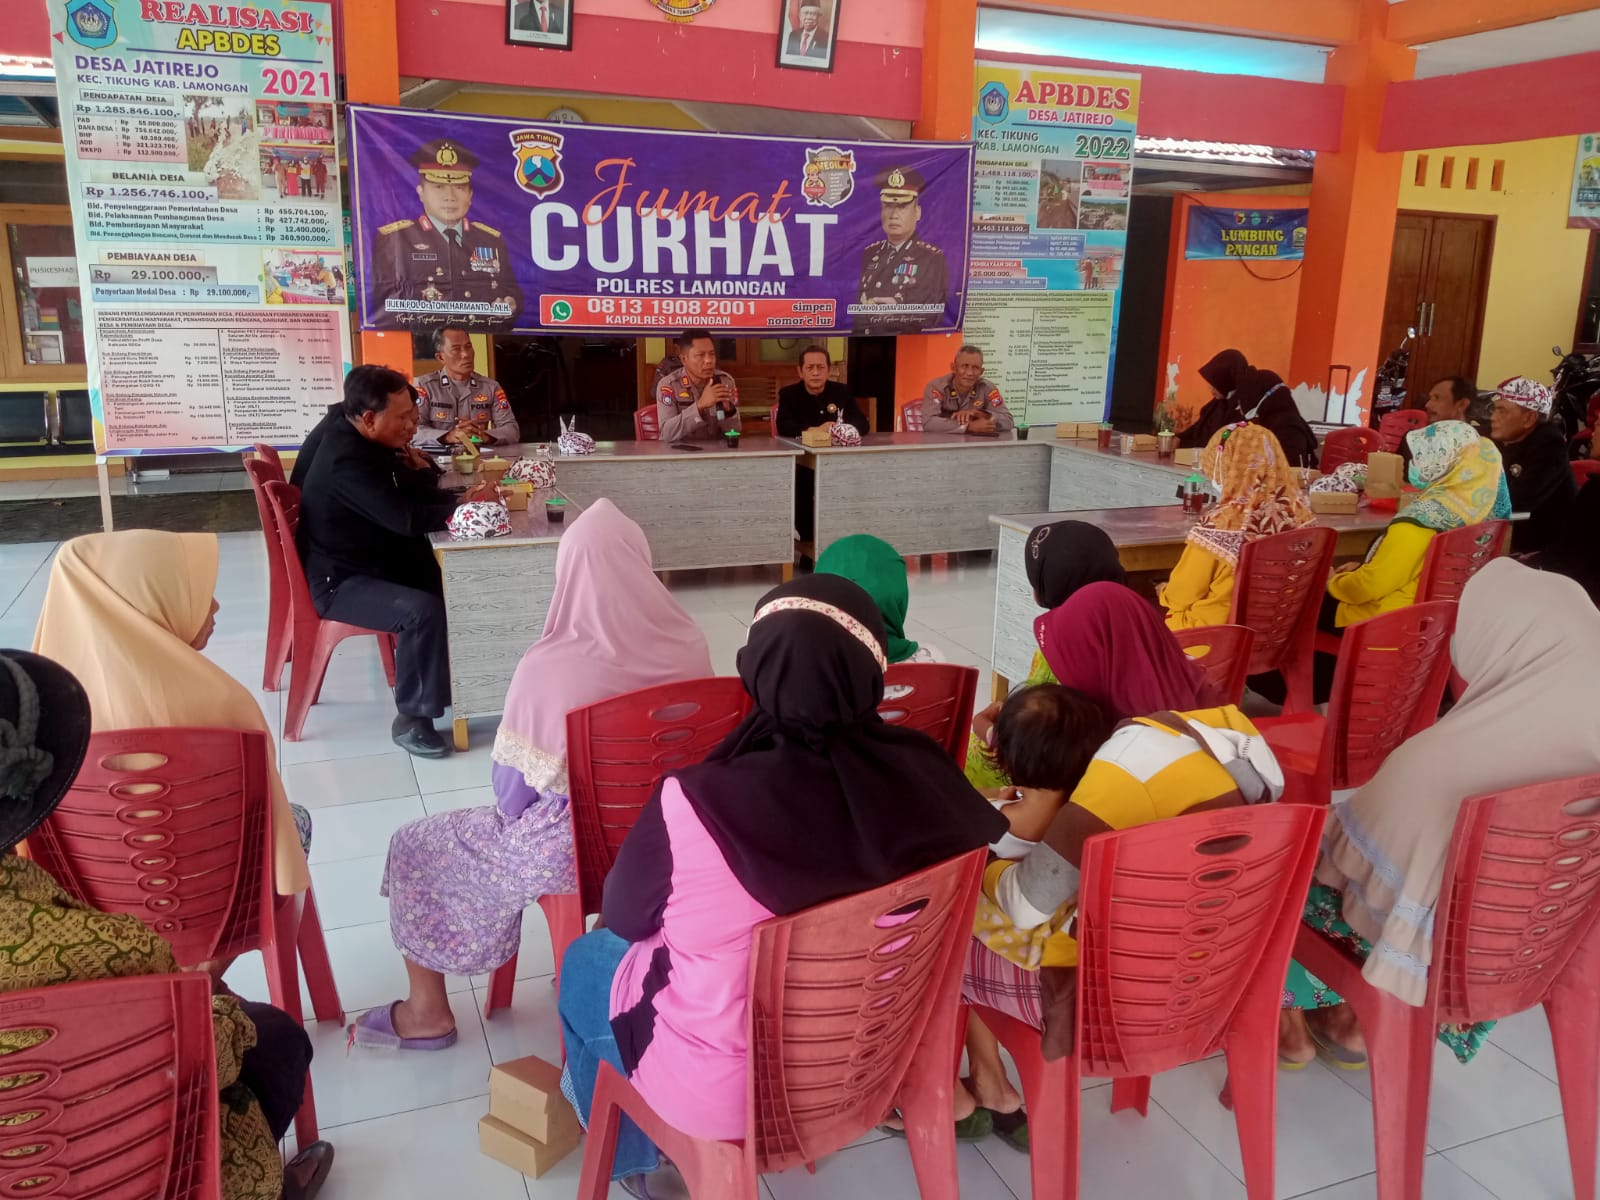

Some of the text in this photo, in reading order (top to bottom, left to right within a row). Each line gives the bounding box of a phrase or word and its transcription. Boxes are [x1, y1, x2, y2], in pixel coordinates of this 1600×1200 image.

[140, 0, 313, 33] REALISASI
[177, 28, 280, 56] APBDES
[75, 55, 219, 78] DESA JATIREJO
[77, 74, 248, 93] KEC. TIKUNG KAB. LAMONGAN
[261, 68, 330, 97] 2021
[83, 92, 142, 102] PENDAPATAN
[1014, 80, 1130, 110] APBDES
[76, 104, 91, 114] Rp
[1028, 109, 1114, 125] DESA JATIREJO
[516, 134, 558, 144] JAWA TIMUR
[977, 130, 1039, 141] KEC. TIKUNG
[976, 142, 1059, 155] KAB. LAMONGAN
[1075, 135, 1131, 159] 2022
[112, 172, 185, 182] BELANJA DESA
[86, 187, 104, 198] Rp
[582, 157, 793, 226] Jumat
[264, 207, 274, 216] Rp
[265, 216, 274, 224] Rp
[265, 225, 275, 233] Rp
[266, 234, 276, 242] Rp
[531, 201, 839, 277] CURHAT
[1221, 229, 1284, 242] LUMBUNG
[1225, 244, 1278, 256] PANGAN
[107, 252, 197, 262] PEMBIAYAAN DESA
[94, 269, 111, 281] Rp
[190, 288, 200, 297] Rp
[596, 278, 786, 296] POLRES LAMONGAN
[587, 298, 756, 316] 0813 1908 2001
[791, 301, 833, 314] simpen
[605, 314, 666, 326] KAPOLRES
[668, 315, 731, 326] LAMONGAN
[816, 315, 833, 326] lur
